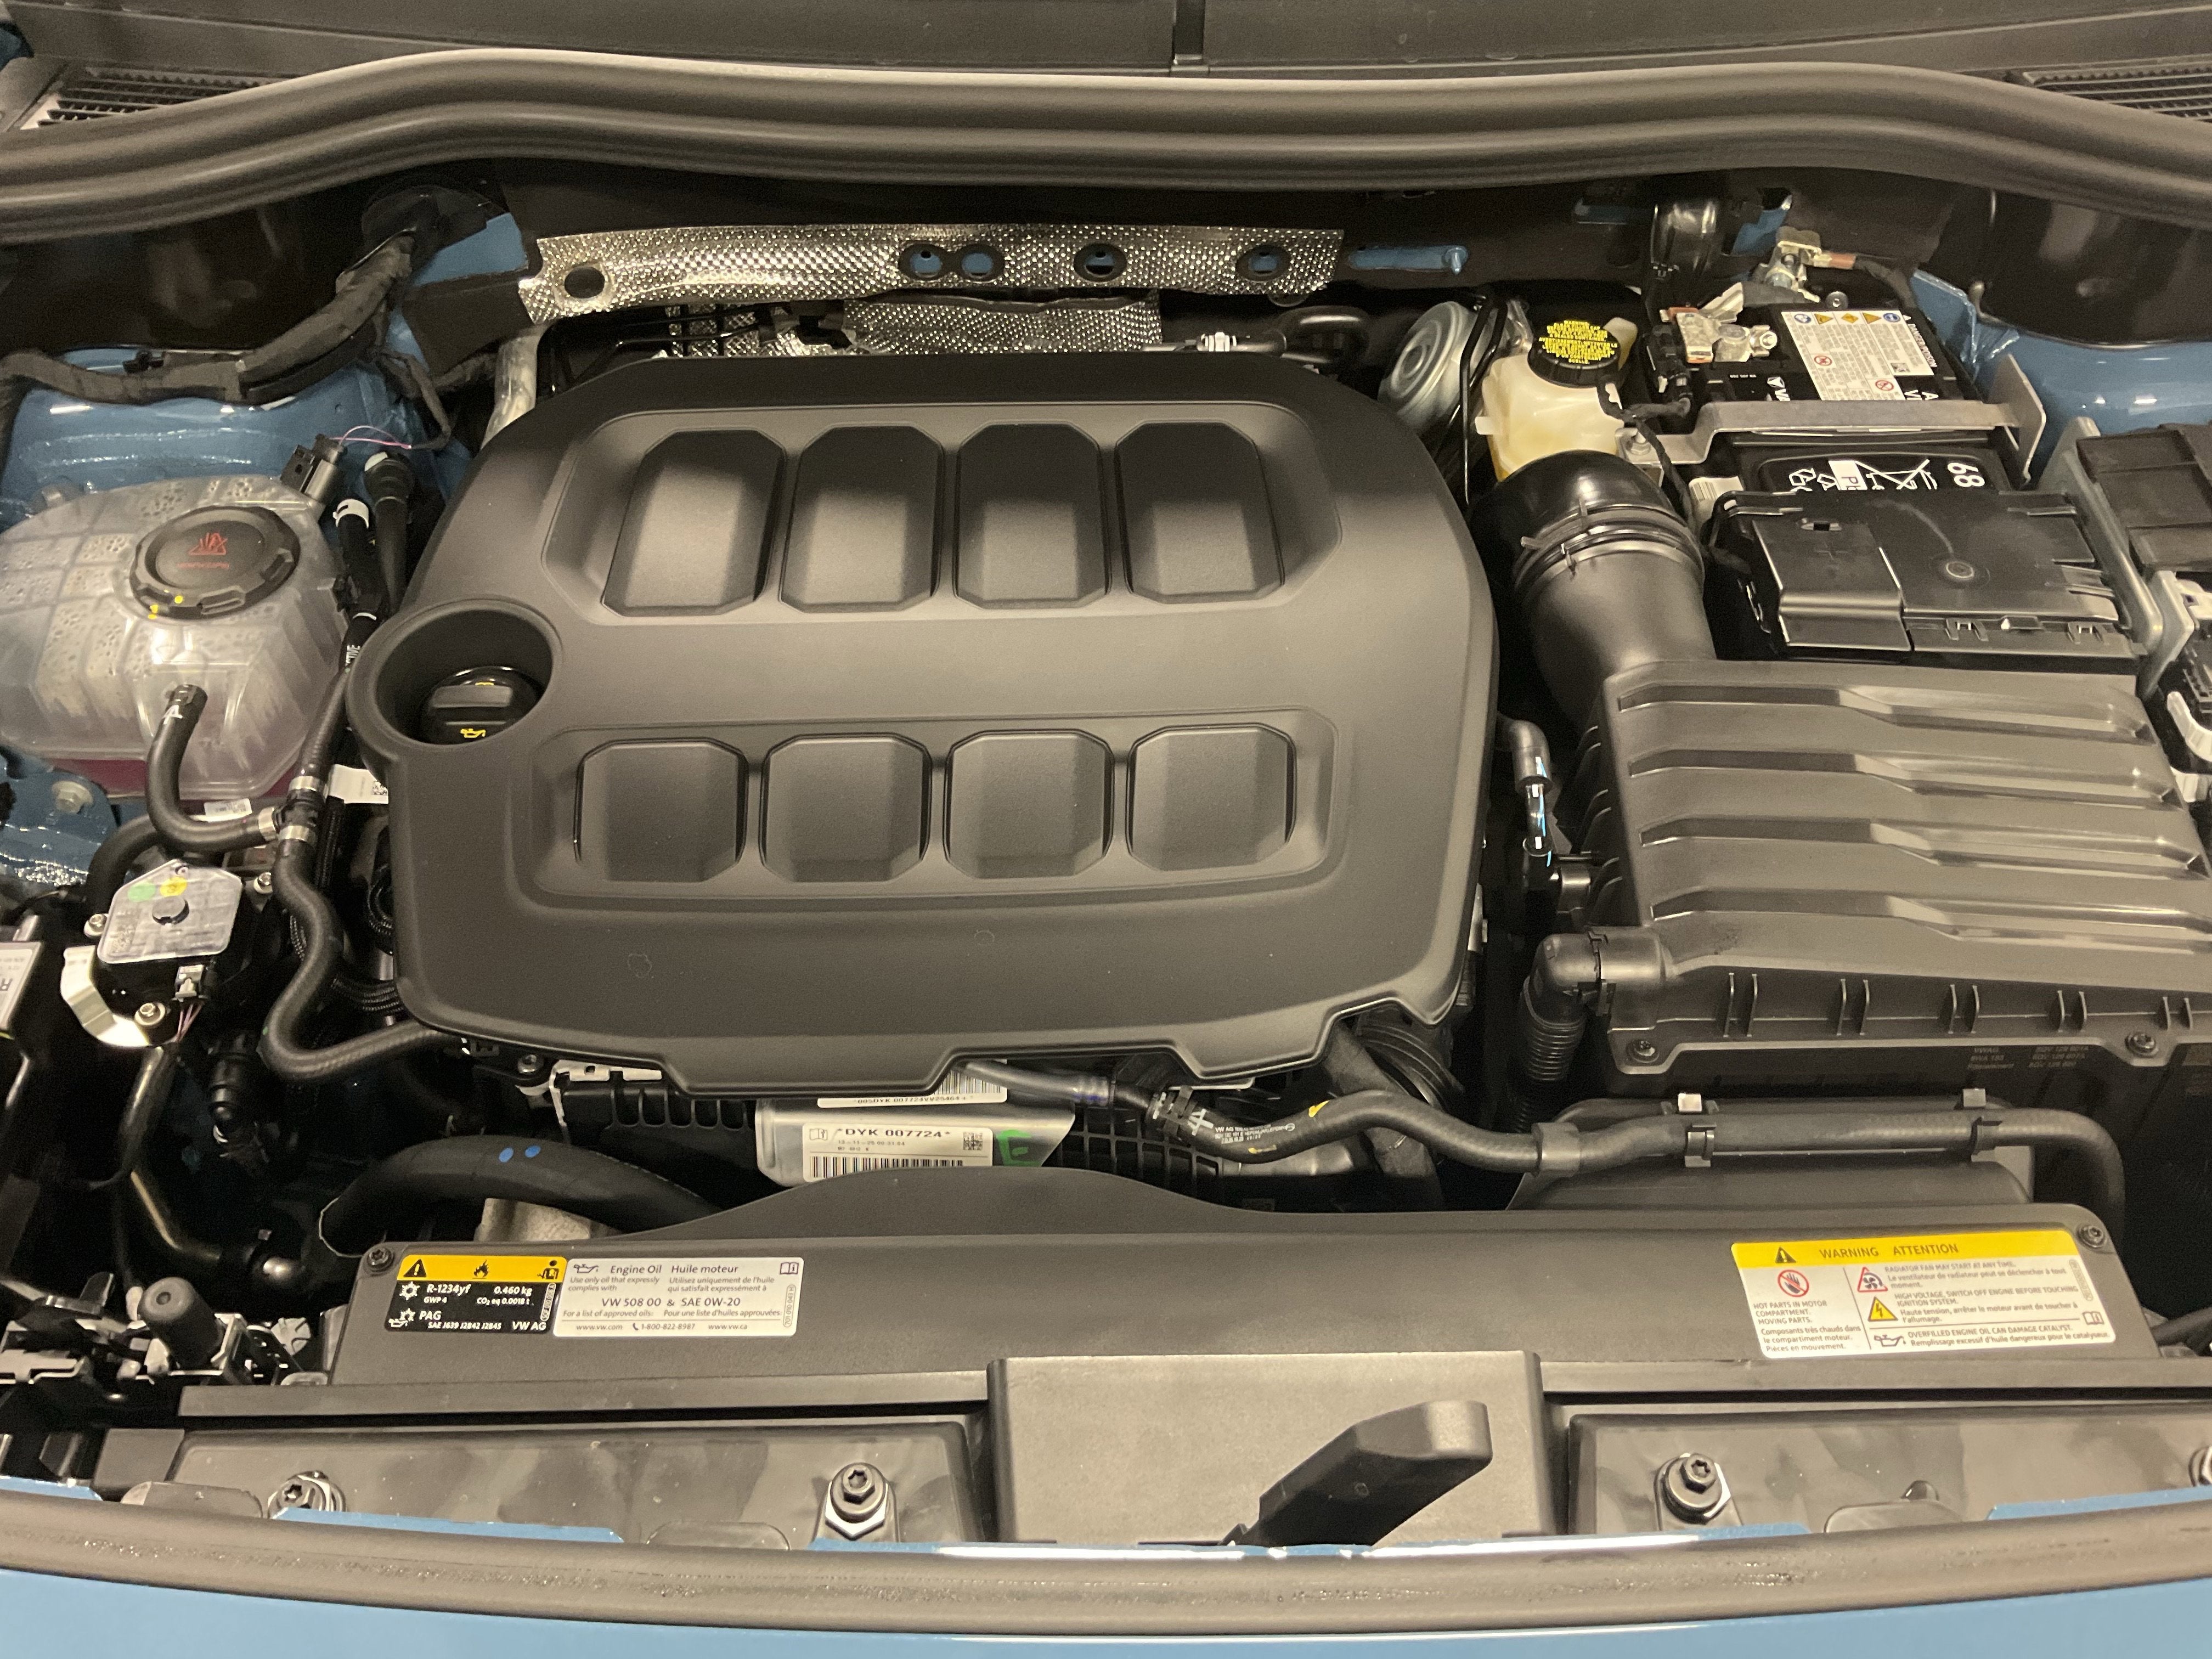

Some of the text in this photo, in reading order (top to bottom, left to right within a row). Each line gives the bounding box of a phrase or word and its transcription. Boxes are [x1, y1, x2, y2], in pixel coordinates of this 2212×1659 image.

[1947, 462, 1985, 488] 68
[1819, 1243, 1959, 1259] WARNING ATTENTION
[611, 1265, 662, 1276] Engine Oil
[672, 1264, 738, 1273] Huile moteur
[697, 1277, 741, 1285] uniquement
[427, 1284, 533, 1296] R-1234yf 0.460 kg
[710, 1285, 760, 1293] expressément
[601, 1298, 622, 1306] VW
[624, 1298, 644, 1307] 508
[646, 1298, 662, 1306] 00
[681, 1297, 702, 1306] SAE
[704, 1297, 741, 1306] 0W-20
[419, 1311, 442, 1321] PAG
[512, 1321, 546, 1330] VW AG
[1908, 1329, 1950, 1338] OVERFILLED
[1772, 1335, 1823, 1344] compartiment
[1911, 1339, 1955, 1347] Remplissage
[1985, 1335, 2008, 1343] d'huile
[2047, 1333, 2063, 1341] pour
